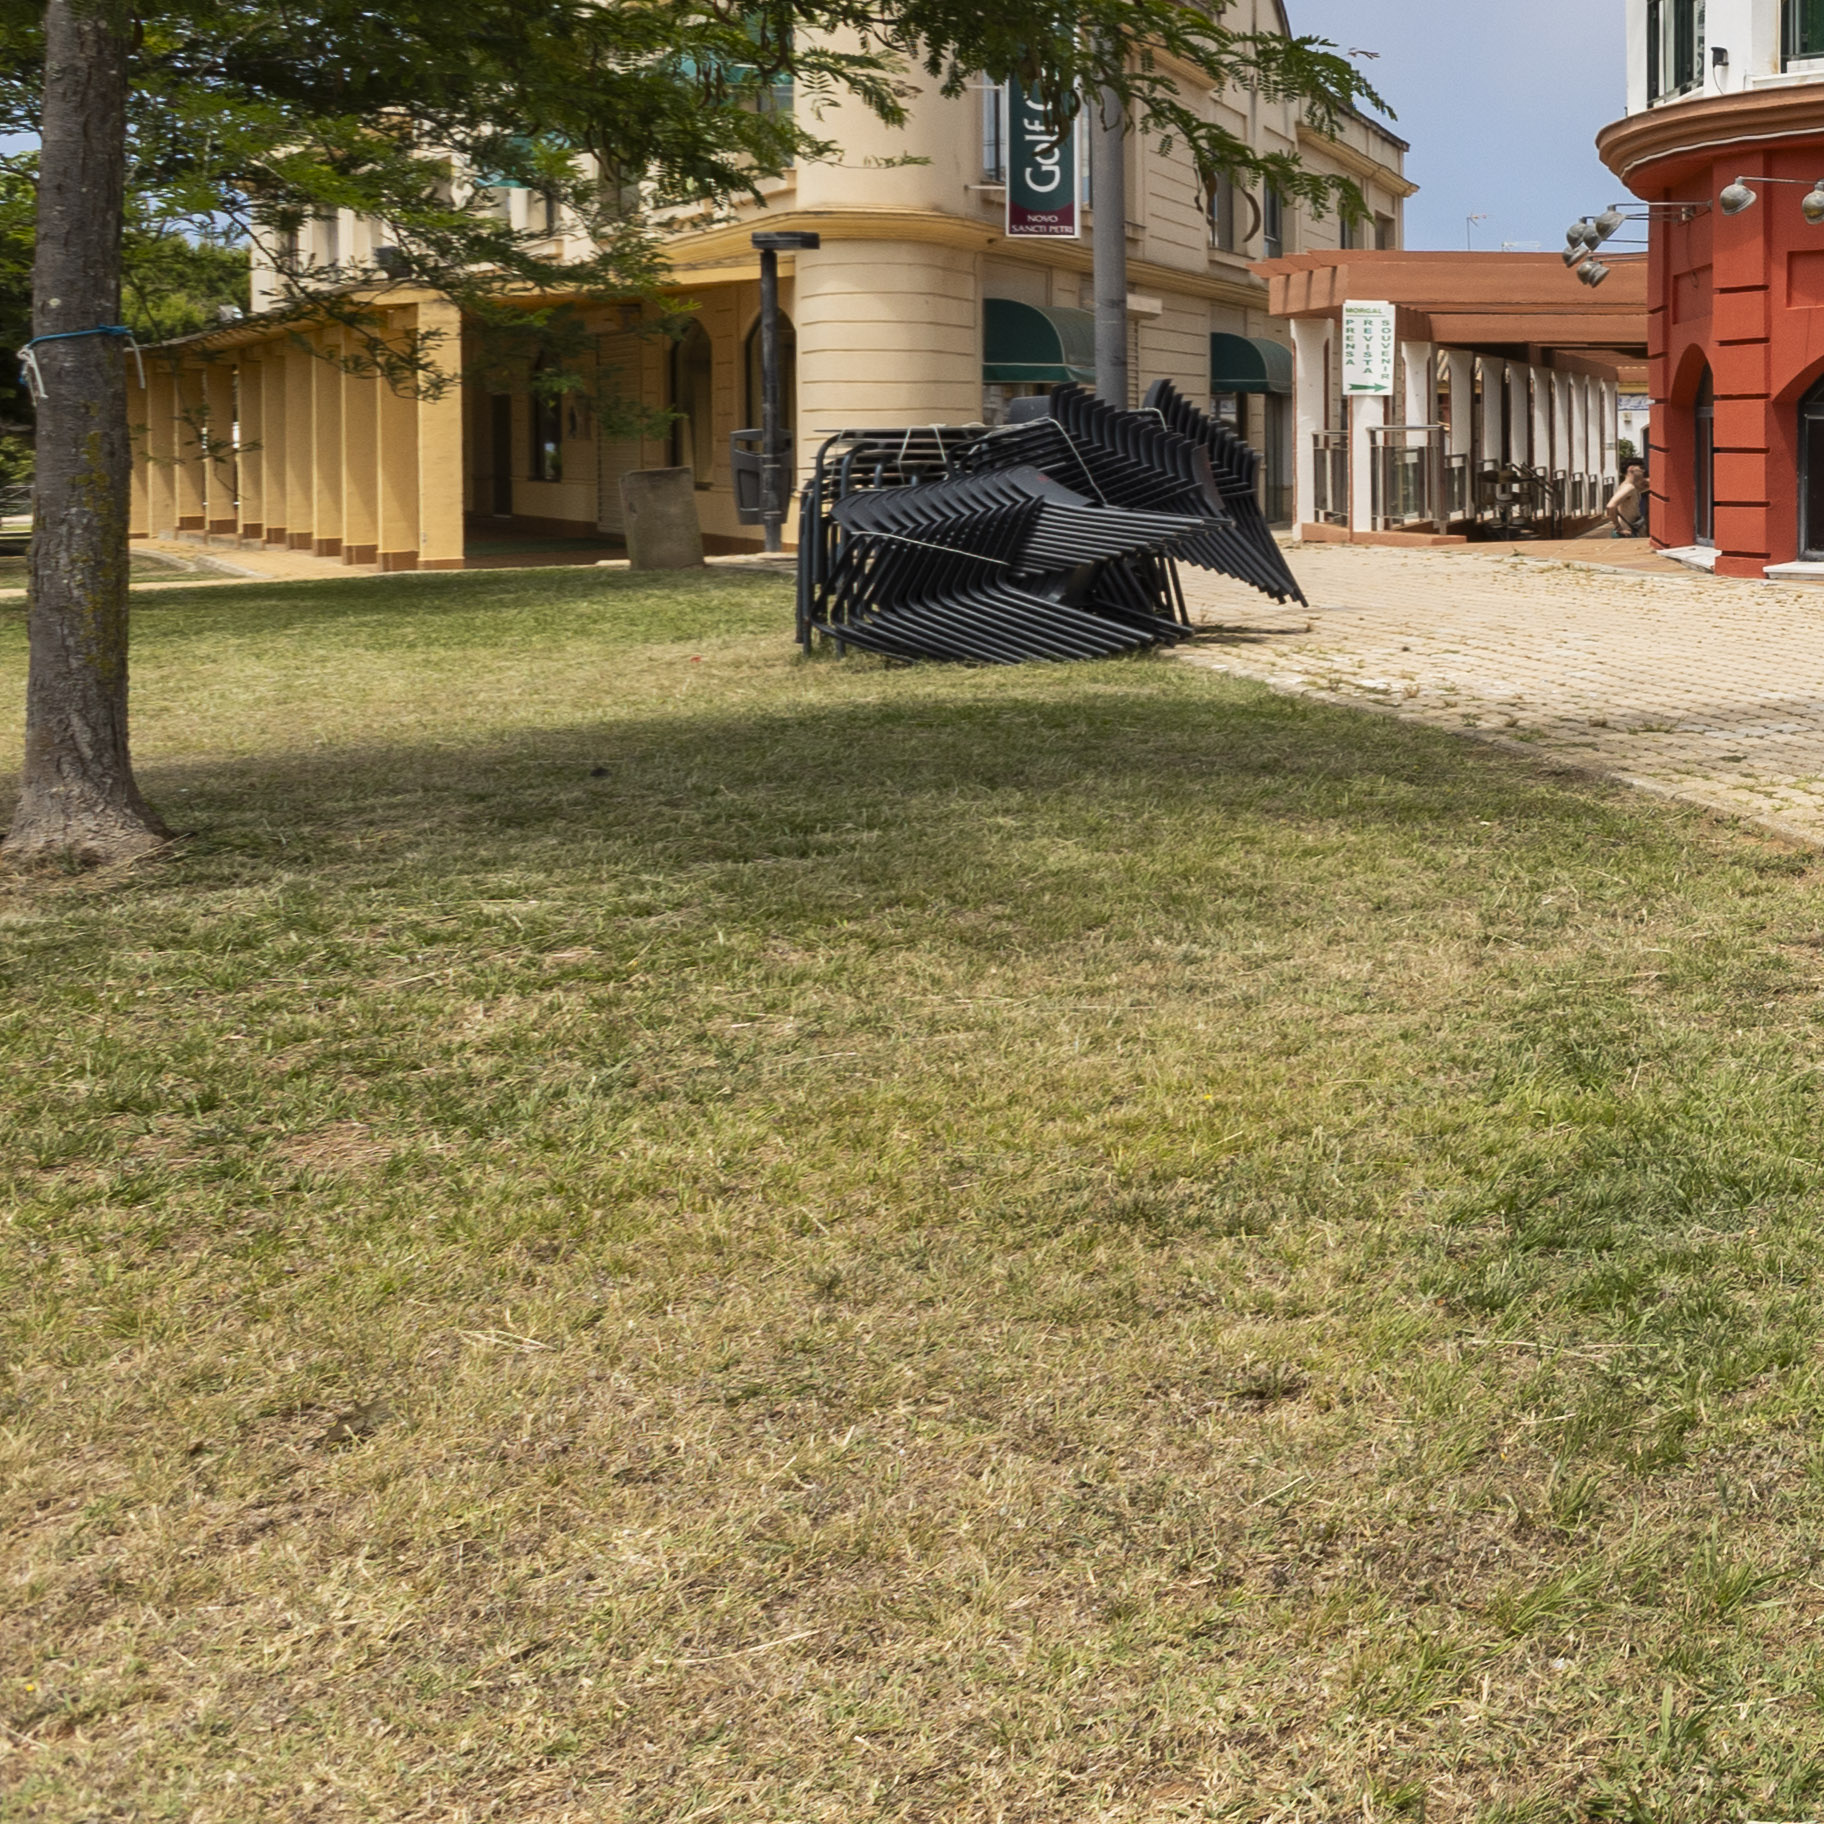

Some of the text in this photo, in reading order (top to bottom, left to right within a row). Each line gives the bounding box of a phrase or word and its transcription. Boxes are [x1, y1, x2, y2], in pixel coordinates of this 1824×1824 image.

[1027, 214, 1058, 223] NOVO
[1345, 319, 1356, 366] PRENSA
[1363, 319, 1374, 374] REVISTA
[1381, 319, 1392, 380] SOUVENIR
